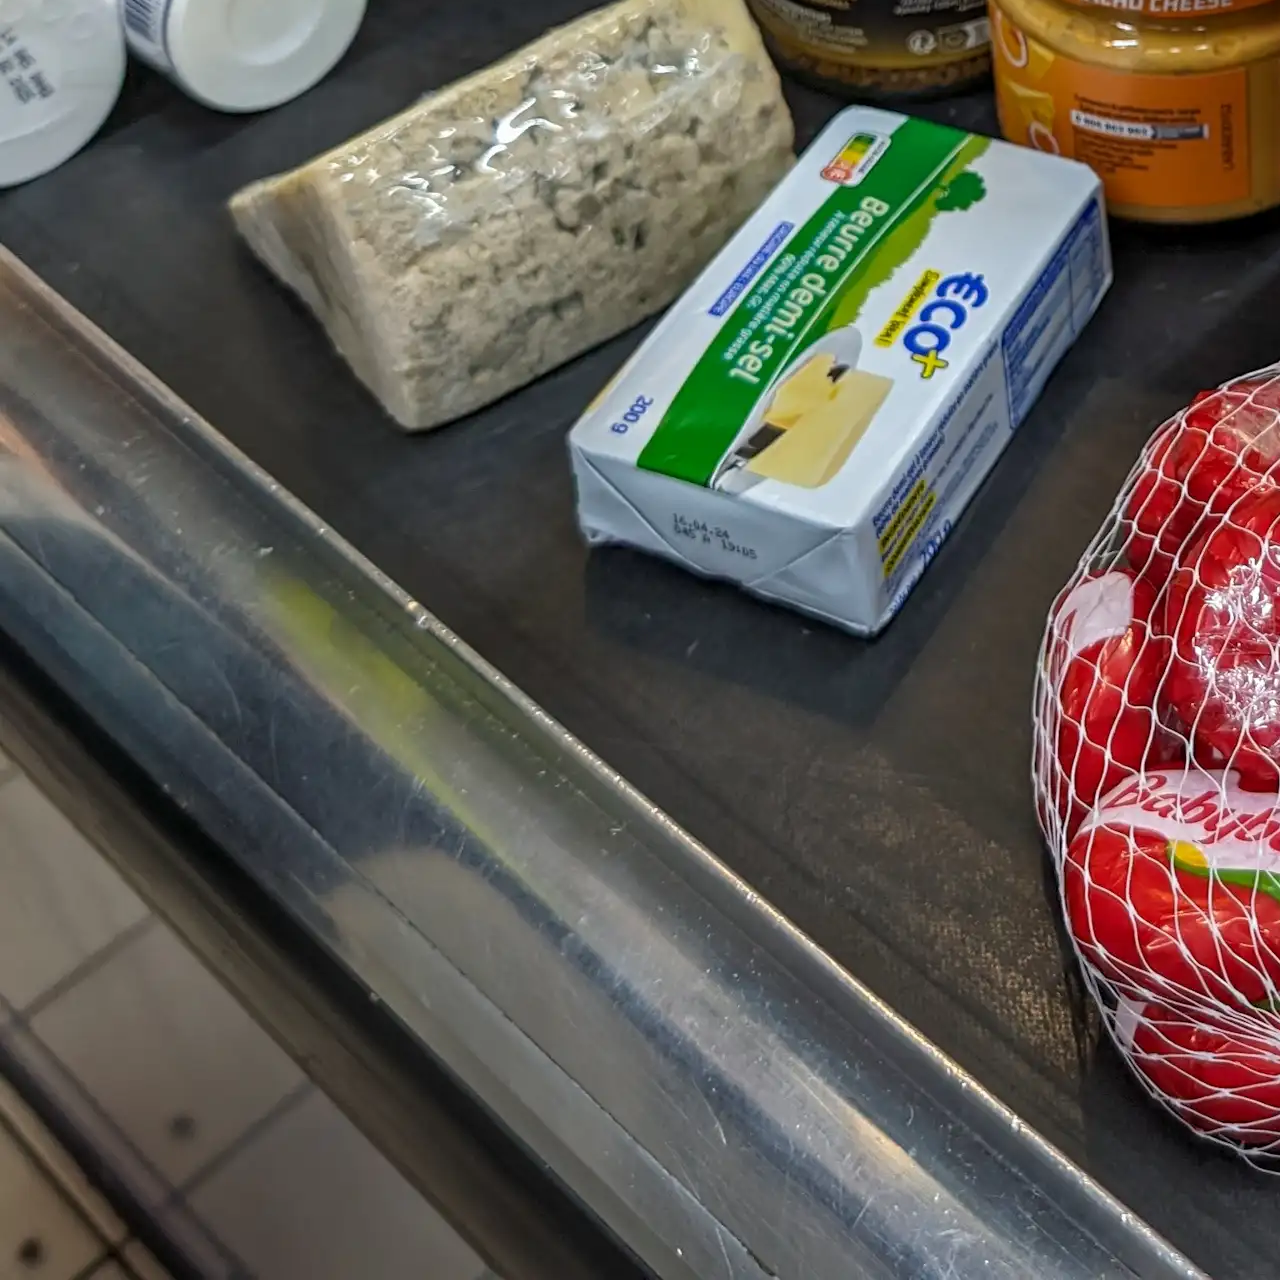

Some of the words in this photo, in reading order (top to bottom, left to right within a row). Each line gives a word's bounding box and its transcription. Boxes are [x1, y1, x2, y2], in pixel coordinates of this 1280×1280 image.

[818, 195, 891, 271] Beurre
[728, 270, 828, 385] demi-sel
[608, 422, 630, 435] g
[620, 394, 654, 423] 200
